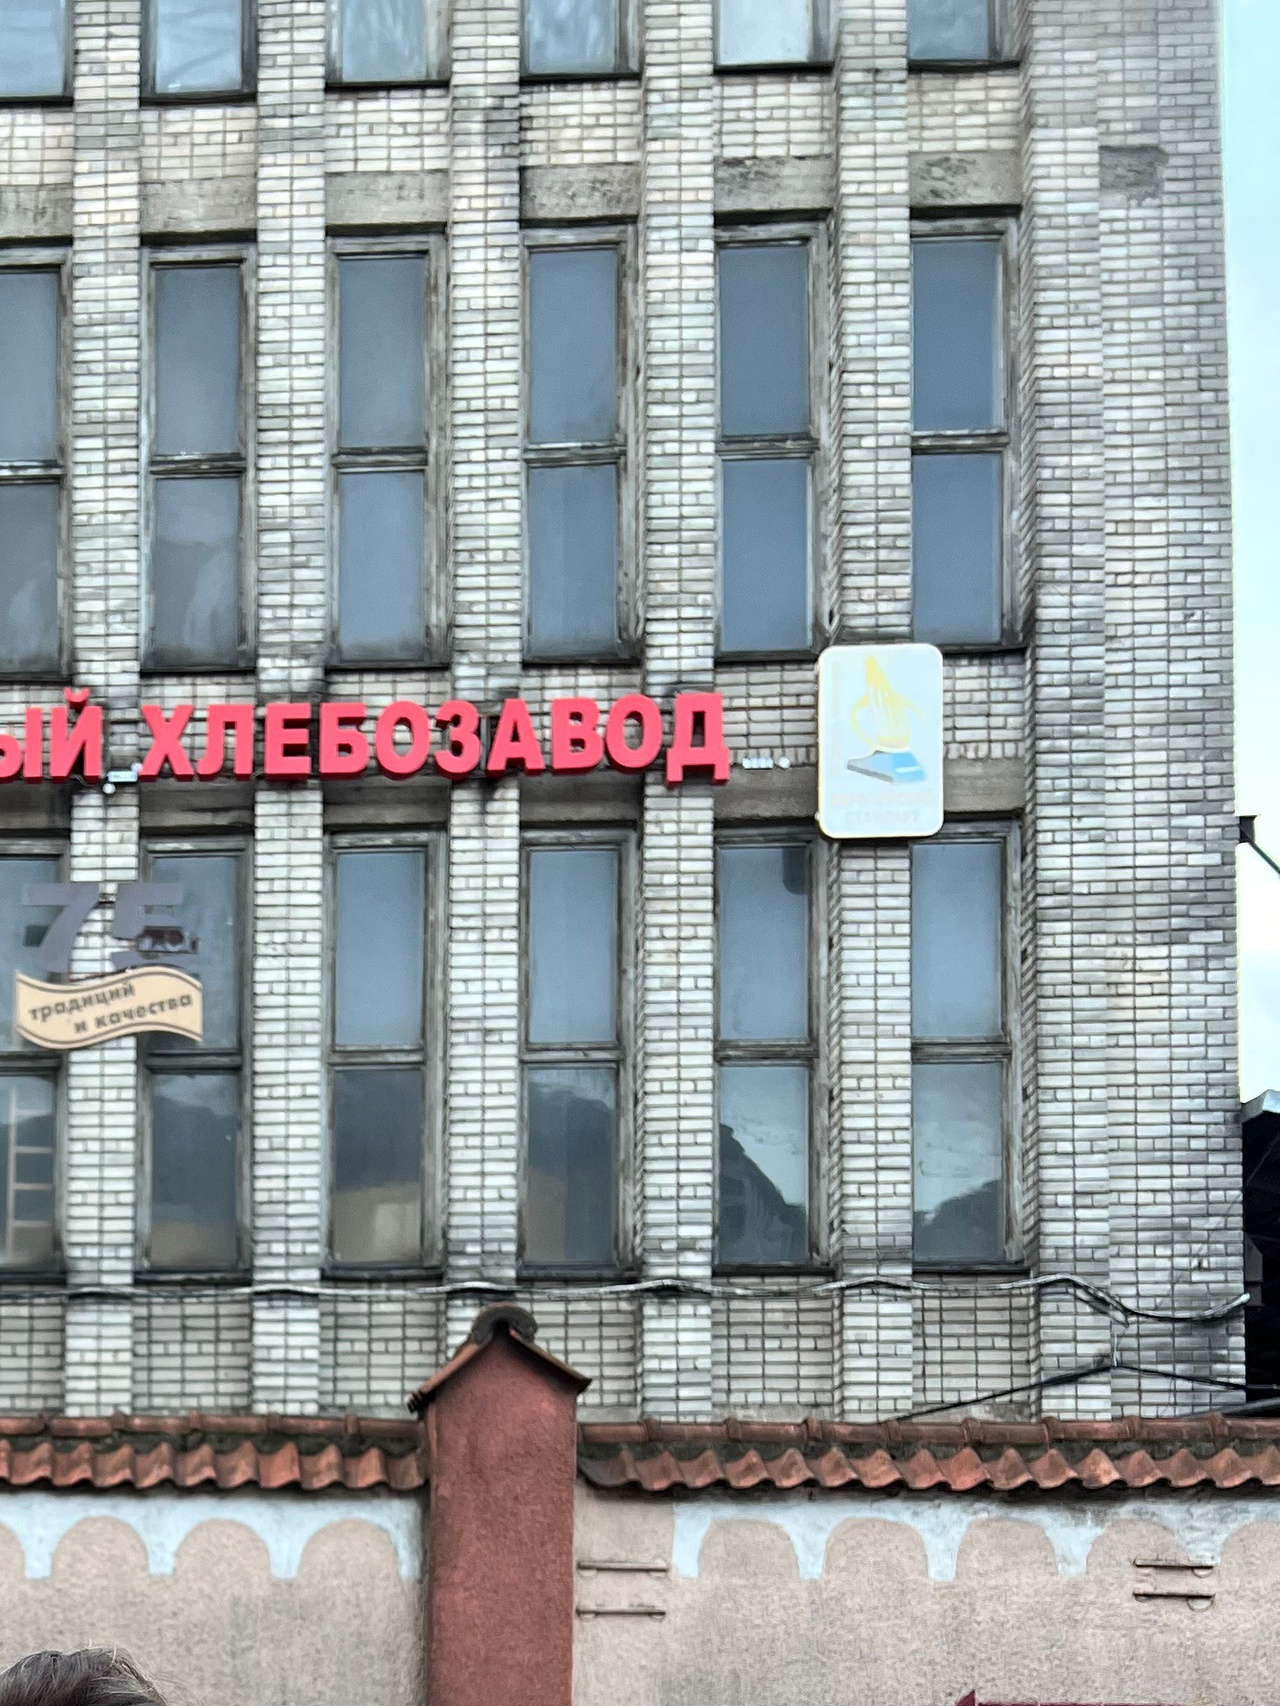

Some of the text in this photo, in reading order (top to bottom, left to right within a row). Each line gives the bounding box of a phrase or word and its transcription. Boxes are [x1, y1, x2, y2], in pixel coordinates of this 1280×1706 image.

[138, 692, 731, 788] ХЛЕБОЗАВОД
[28, 980, 136, 1023] традиций
[74, 994, 194, 1034] и качества
